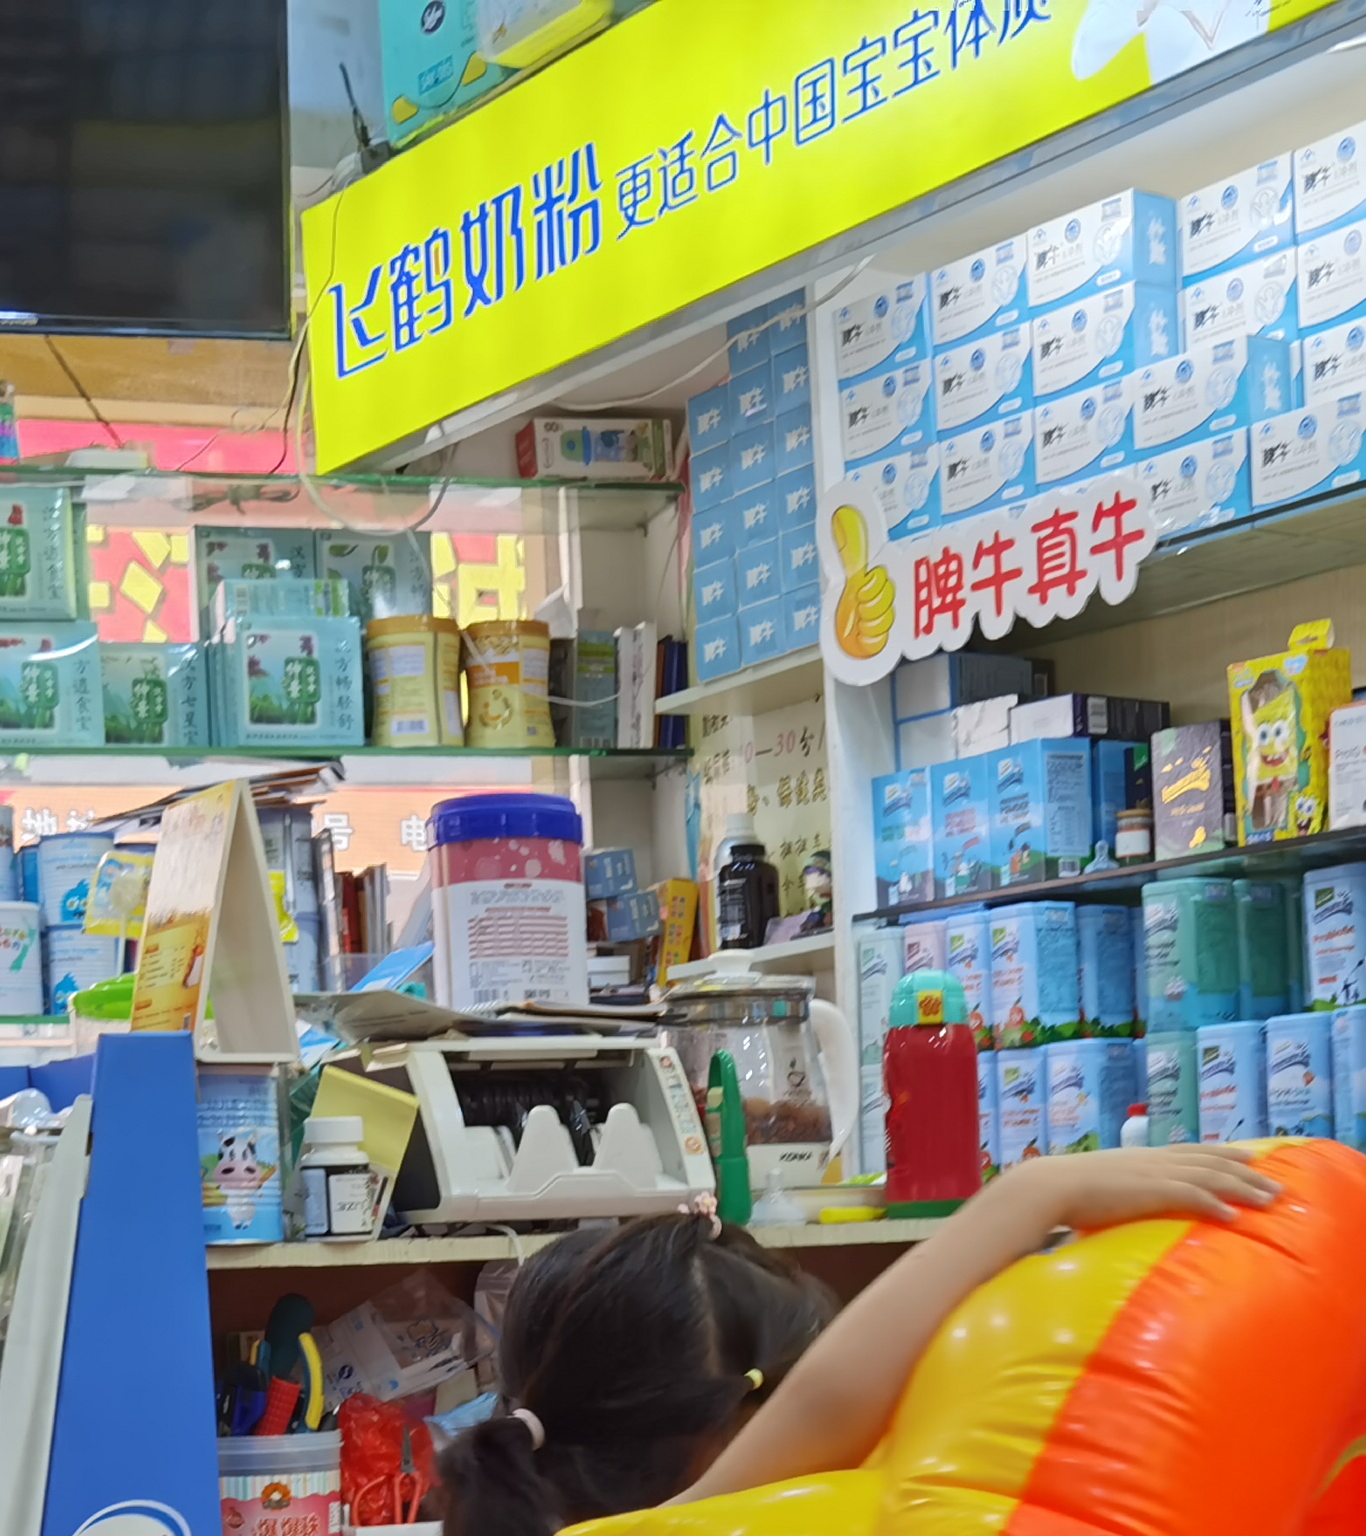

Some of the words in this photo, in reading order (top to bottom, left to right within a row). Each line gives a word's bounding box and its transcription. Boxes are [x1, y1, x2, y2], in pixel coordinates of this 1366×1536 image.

[329, 141, 603, 379] 飞鹤奶粉
[914, 490, 1146, 640] 脾牛真牛
